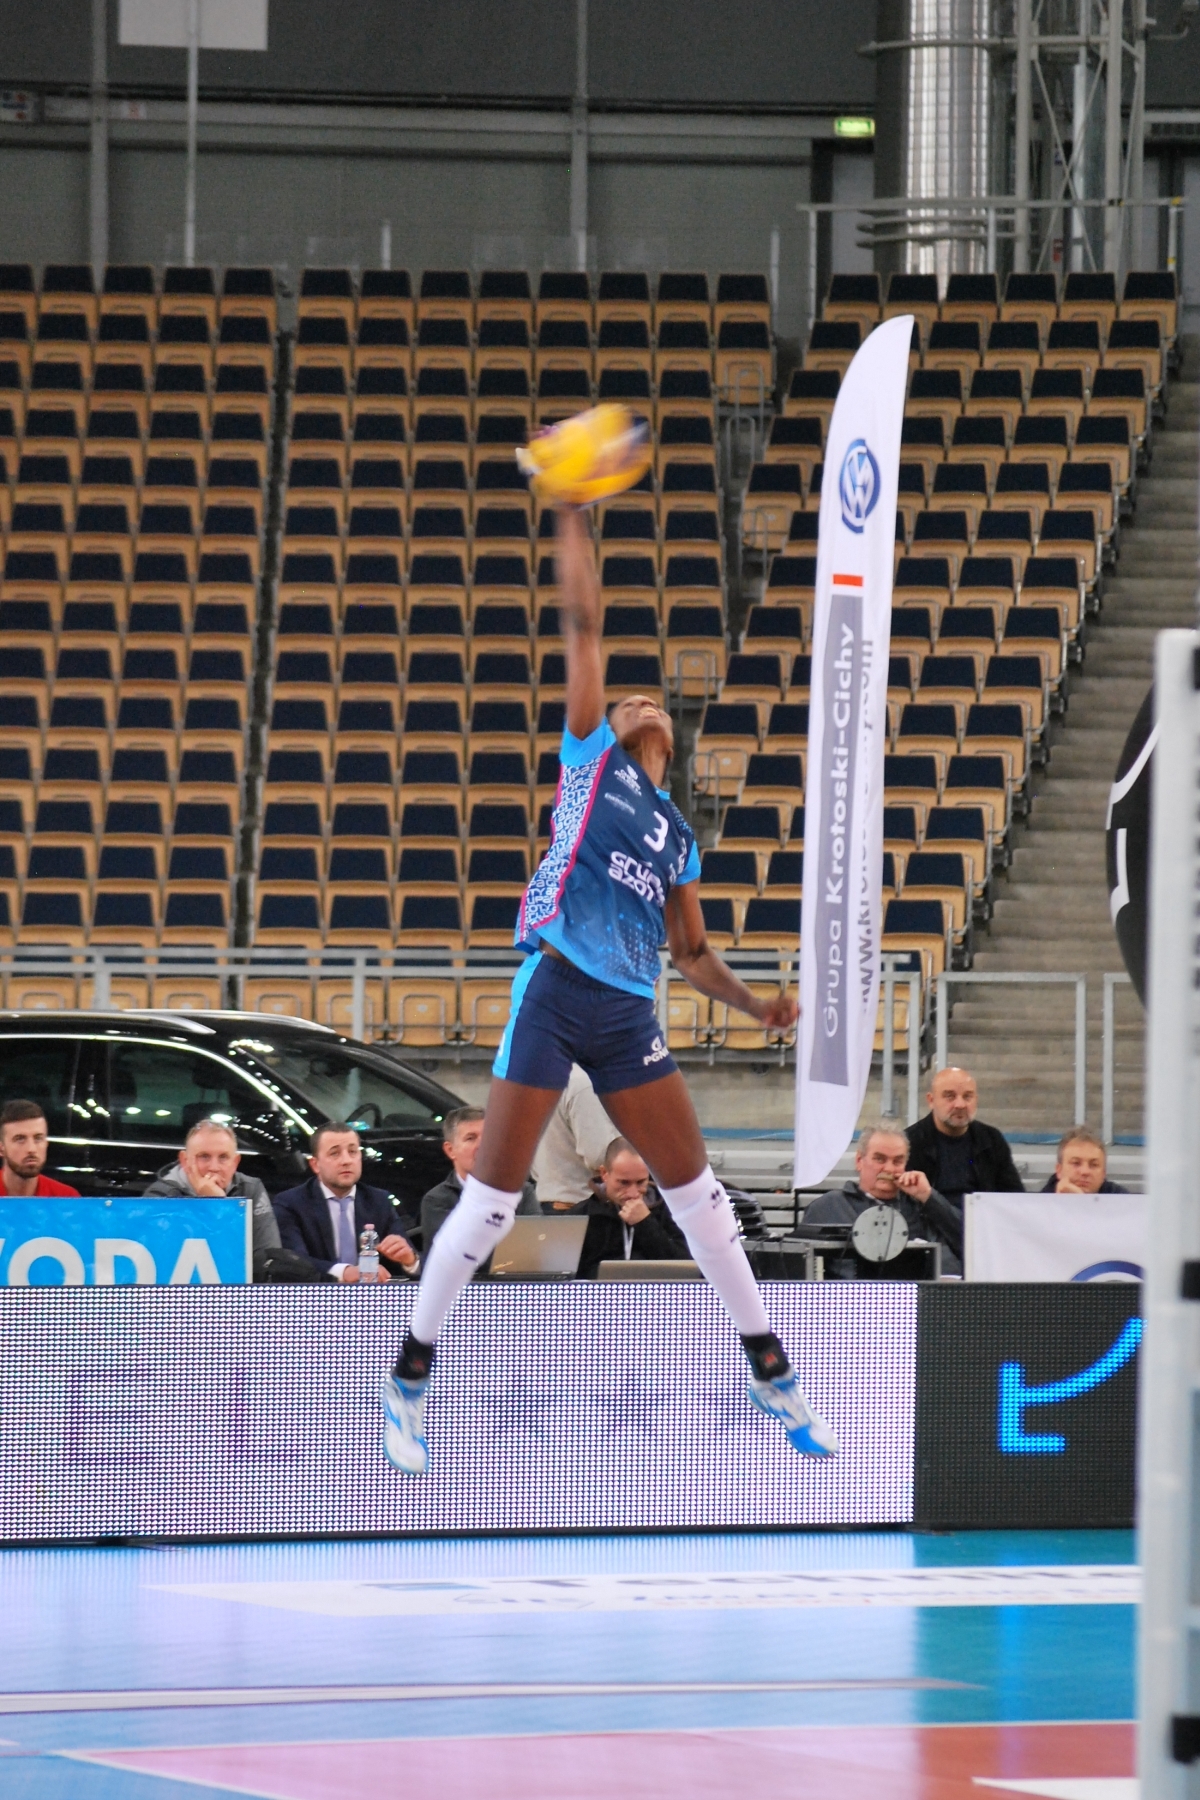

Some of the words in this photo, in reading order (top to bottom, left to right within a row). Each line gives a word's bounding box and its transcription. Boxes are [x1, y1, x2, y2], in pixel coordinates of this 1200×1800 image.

[826, 622, 854, 904] Krotoski-Cichy
[643, 810, 669, 852] 3
[823, 919, 843, 1038] Grupa
[0, 1236, 222, 1285] ODA
